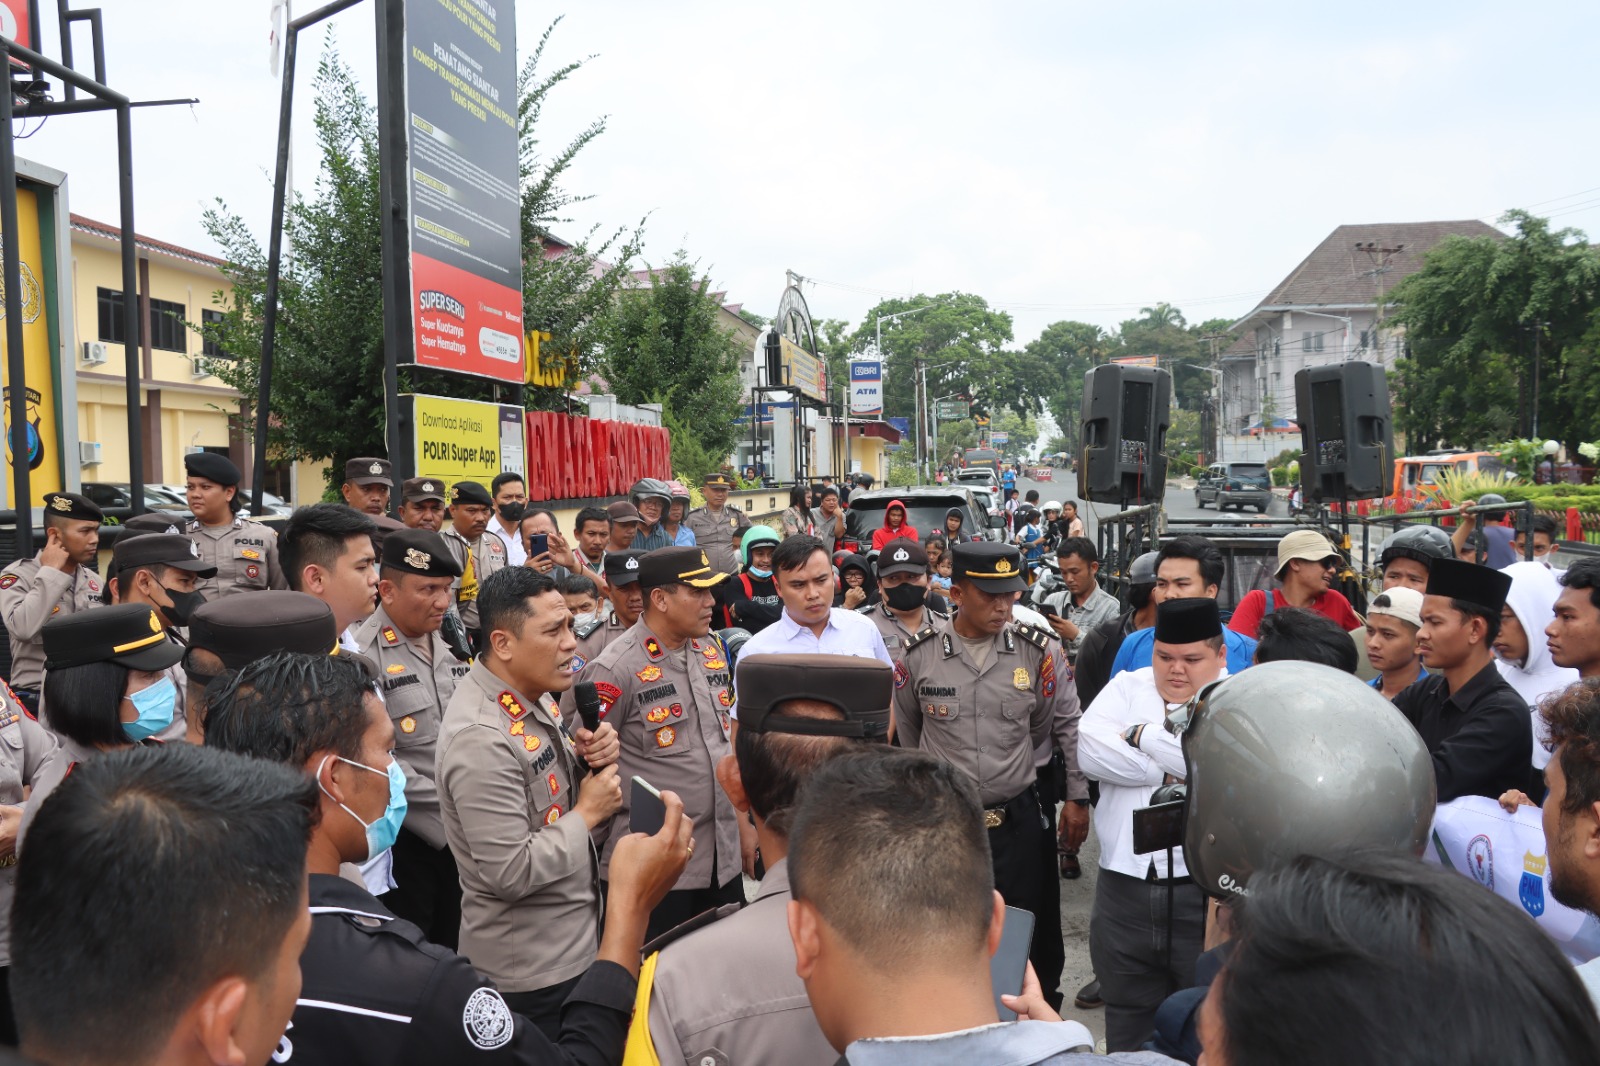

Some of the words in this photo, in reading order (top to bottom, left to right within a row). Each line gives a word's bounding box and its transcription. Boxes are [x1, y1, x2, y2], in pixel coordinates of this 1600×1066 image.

[412, 45, 437, 73] KONSEP
[437, 64, 481, 104] TRANSFORMASI
[433, 42, 472, 82] PEMATANG
[472, 72, 499, 103] SIANTAR
[450, 88, 467, 108] YANG
[467, 100, 487, 122] PRESISI
[421, 316, 436, 330] Super
[436, 318, 464, 339] Kuotanya
[421, 334, 436, 348] Super
[437, 335, 466, 356] Hematnya
[863, 366, 877, 375] BRI
[422, 411, 457, 430] Download
[459, 417, 483, 435] Aplikasi
[423, 440, 450, 461] POLRI
[451, 443, 477, 468] Super
[479, 446, 496, 470] App
[234, 538, 264, 547] POLRI
[1522, 875, 1541, 899] PMII
